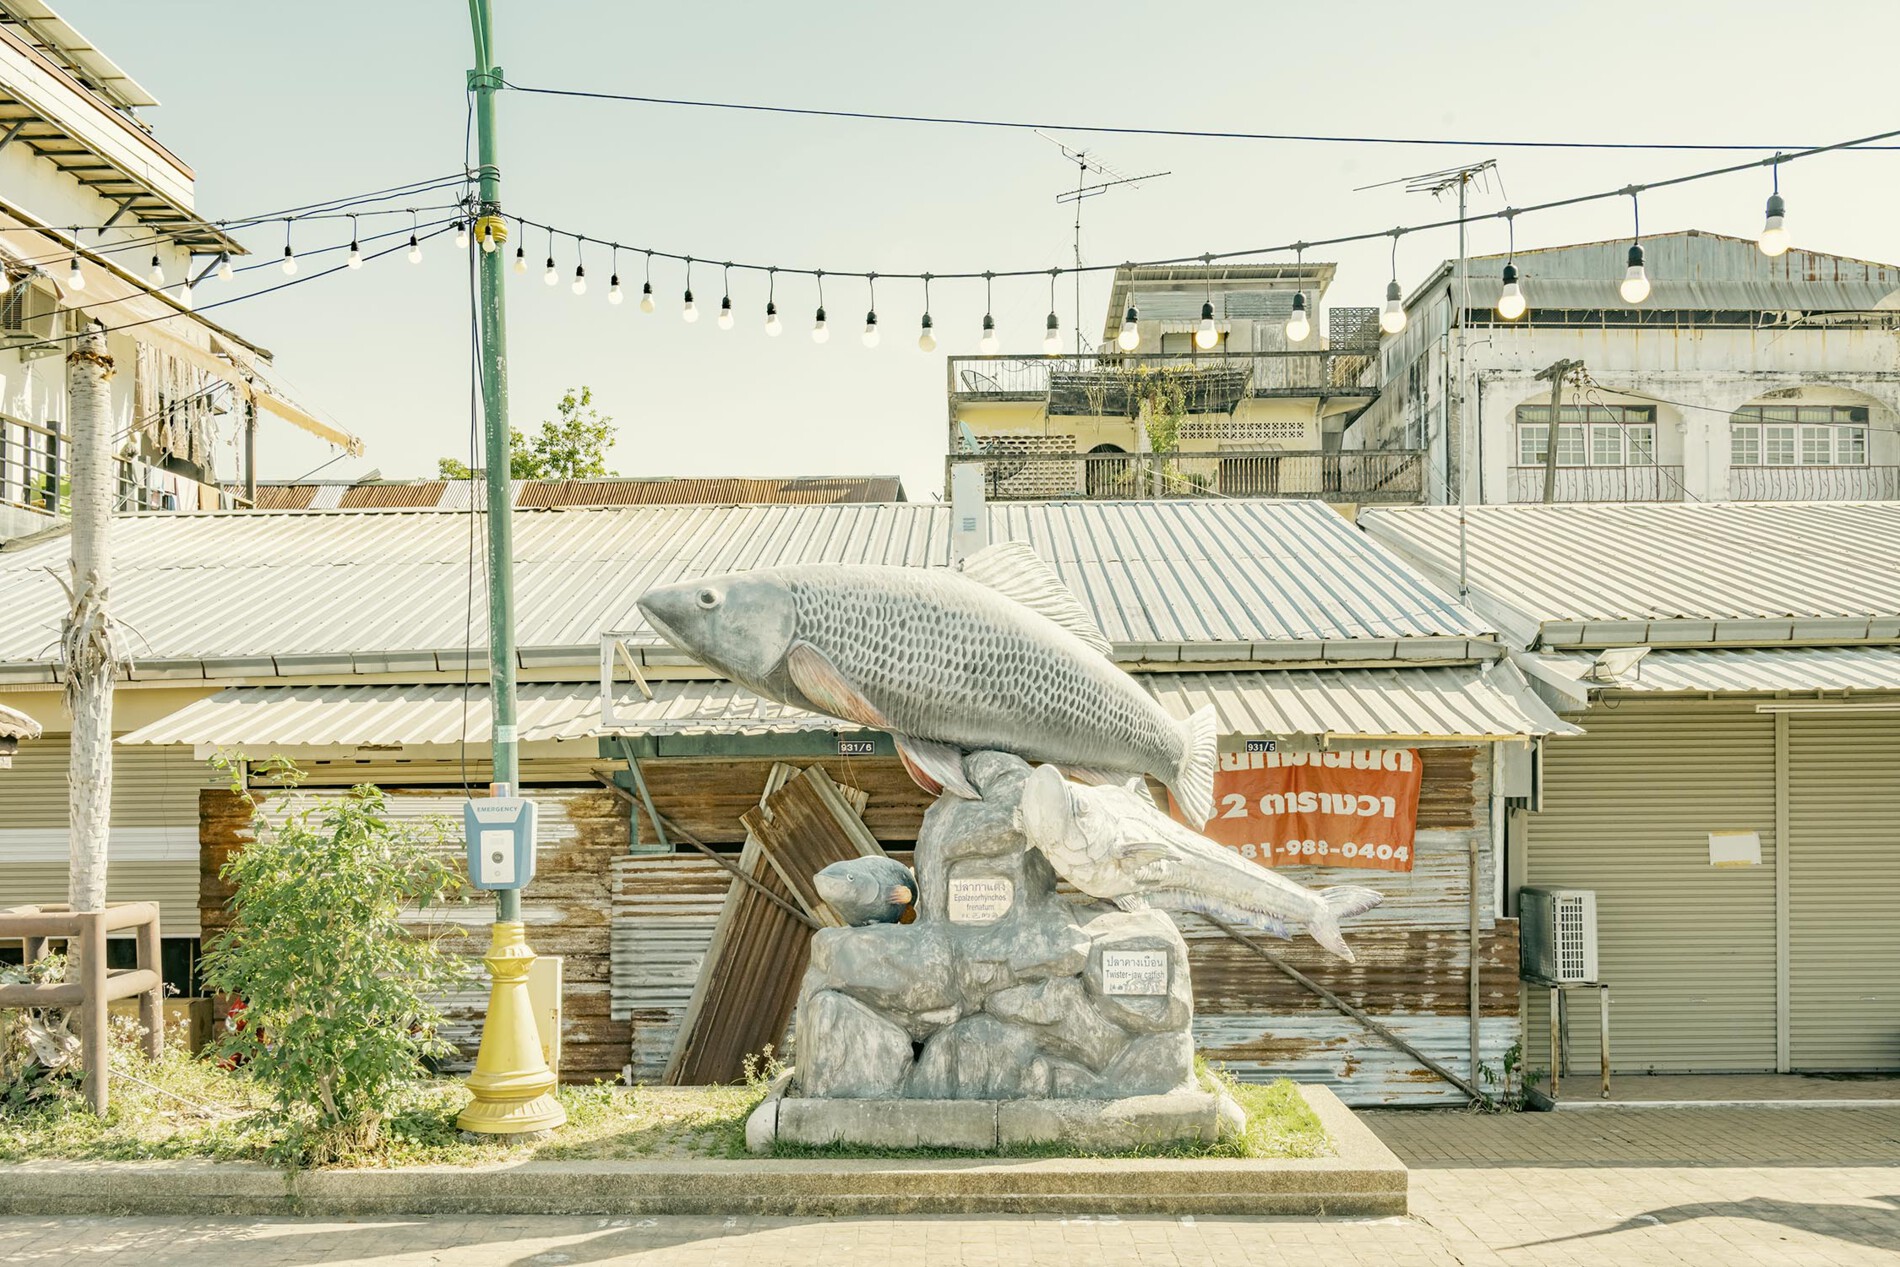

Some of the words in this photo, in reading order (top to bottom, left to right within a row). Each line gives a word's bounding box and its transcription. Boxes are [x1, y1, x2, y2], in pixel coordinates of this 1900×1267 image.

[841, 743, 872, 752] 931/6
[1247, 741, 1275, 752] 931/5
[1260, 791, 1396, 818] ตารางวา
[1105, 969, 1142, 980] Twister-jaw
